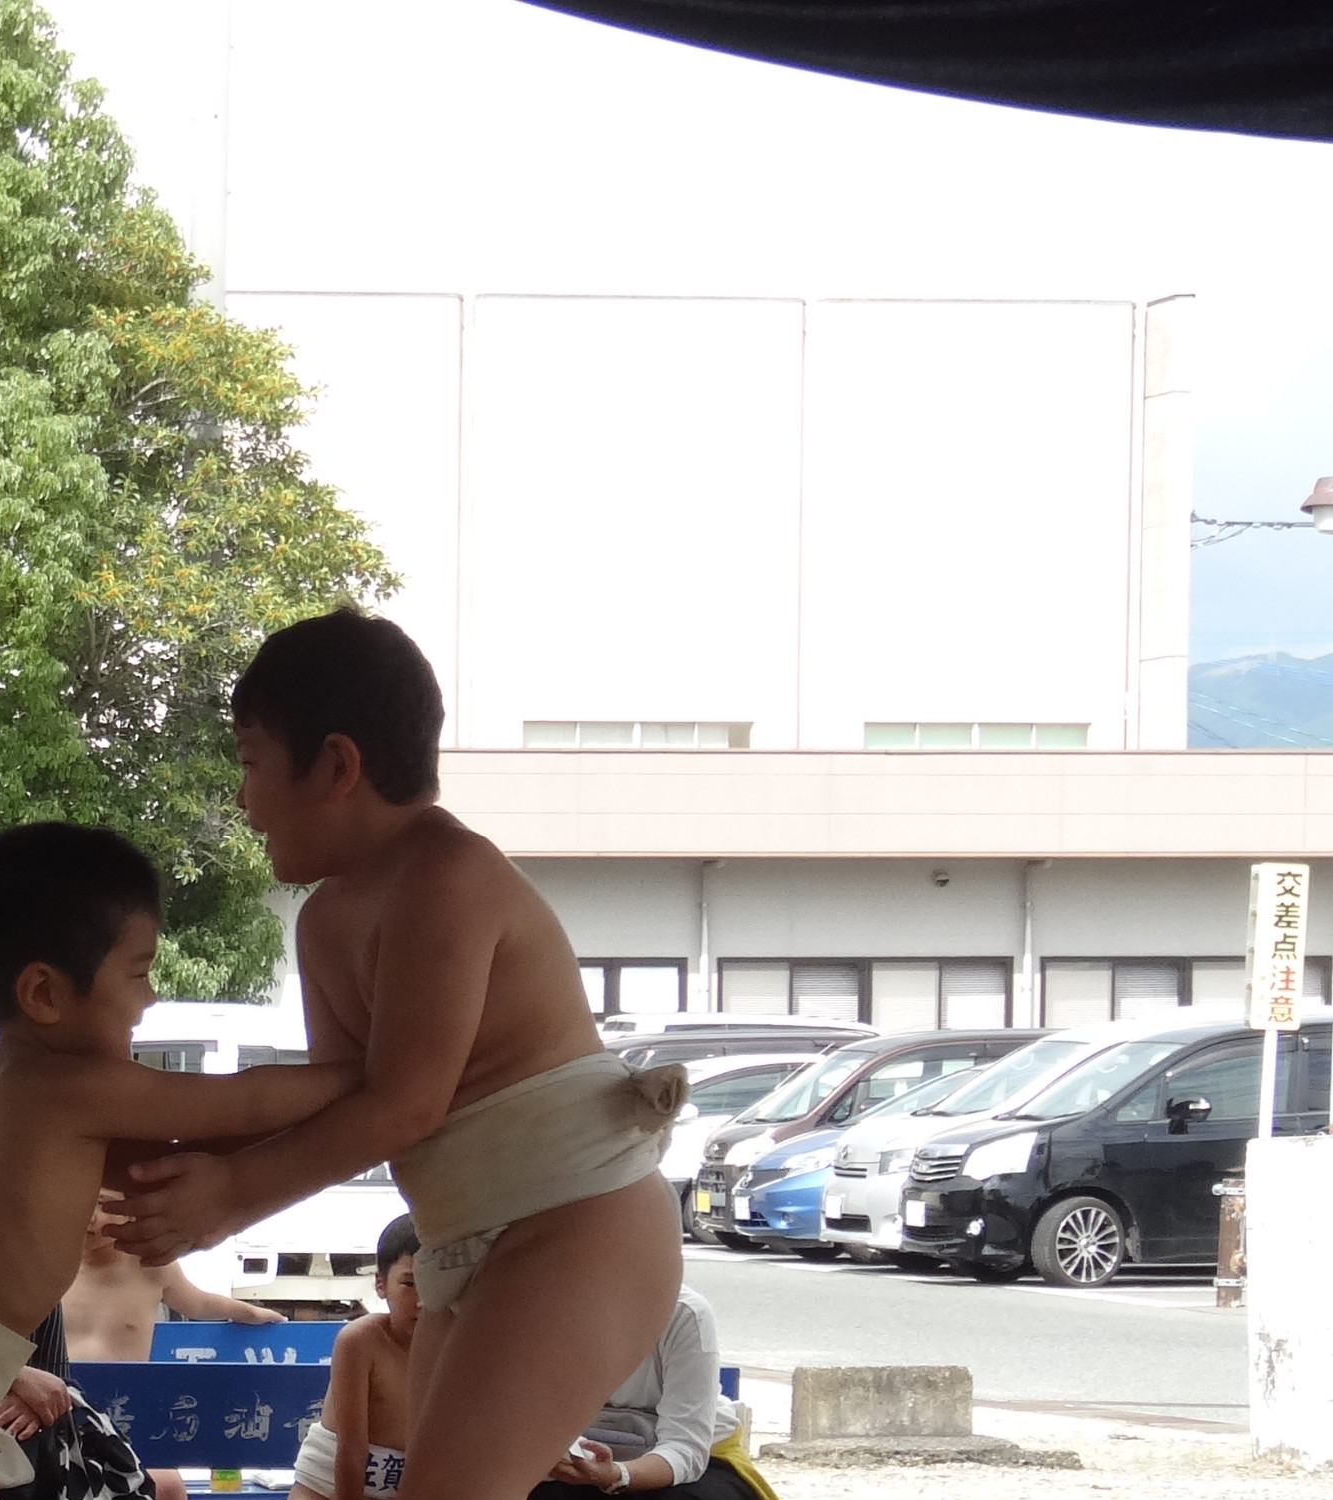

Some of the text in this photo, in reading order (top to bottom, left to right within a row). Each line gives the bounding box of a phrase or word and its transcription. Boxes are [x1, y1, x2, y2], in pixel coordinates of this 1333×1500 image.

[1268, 871, 1303, 1023] 交差点注意
